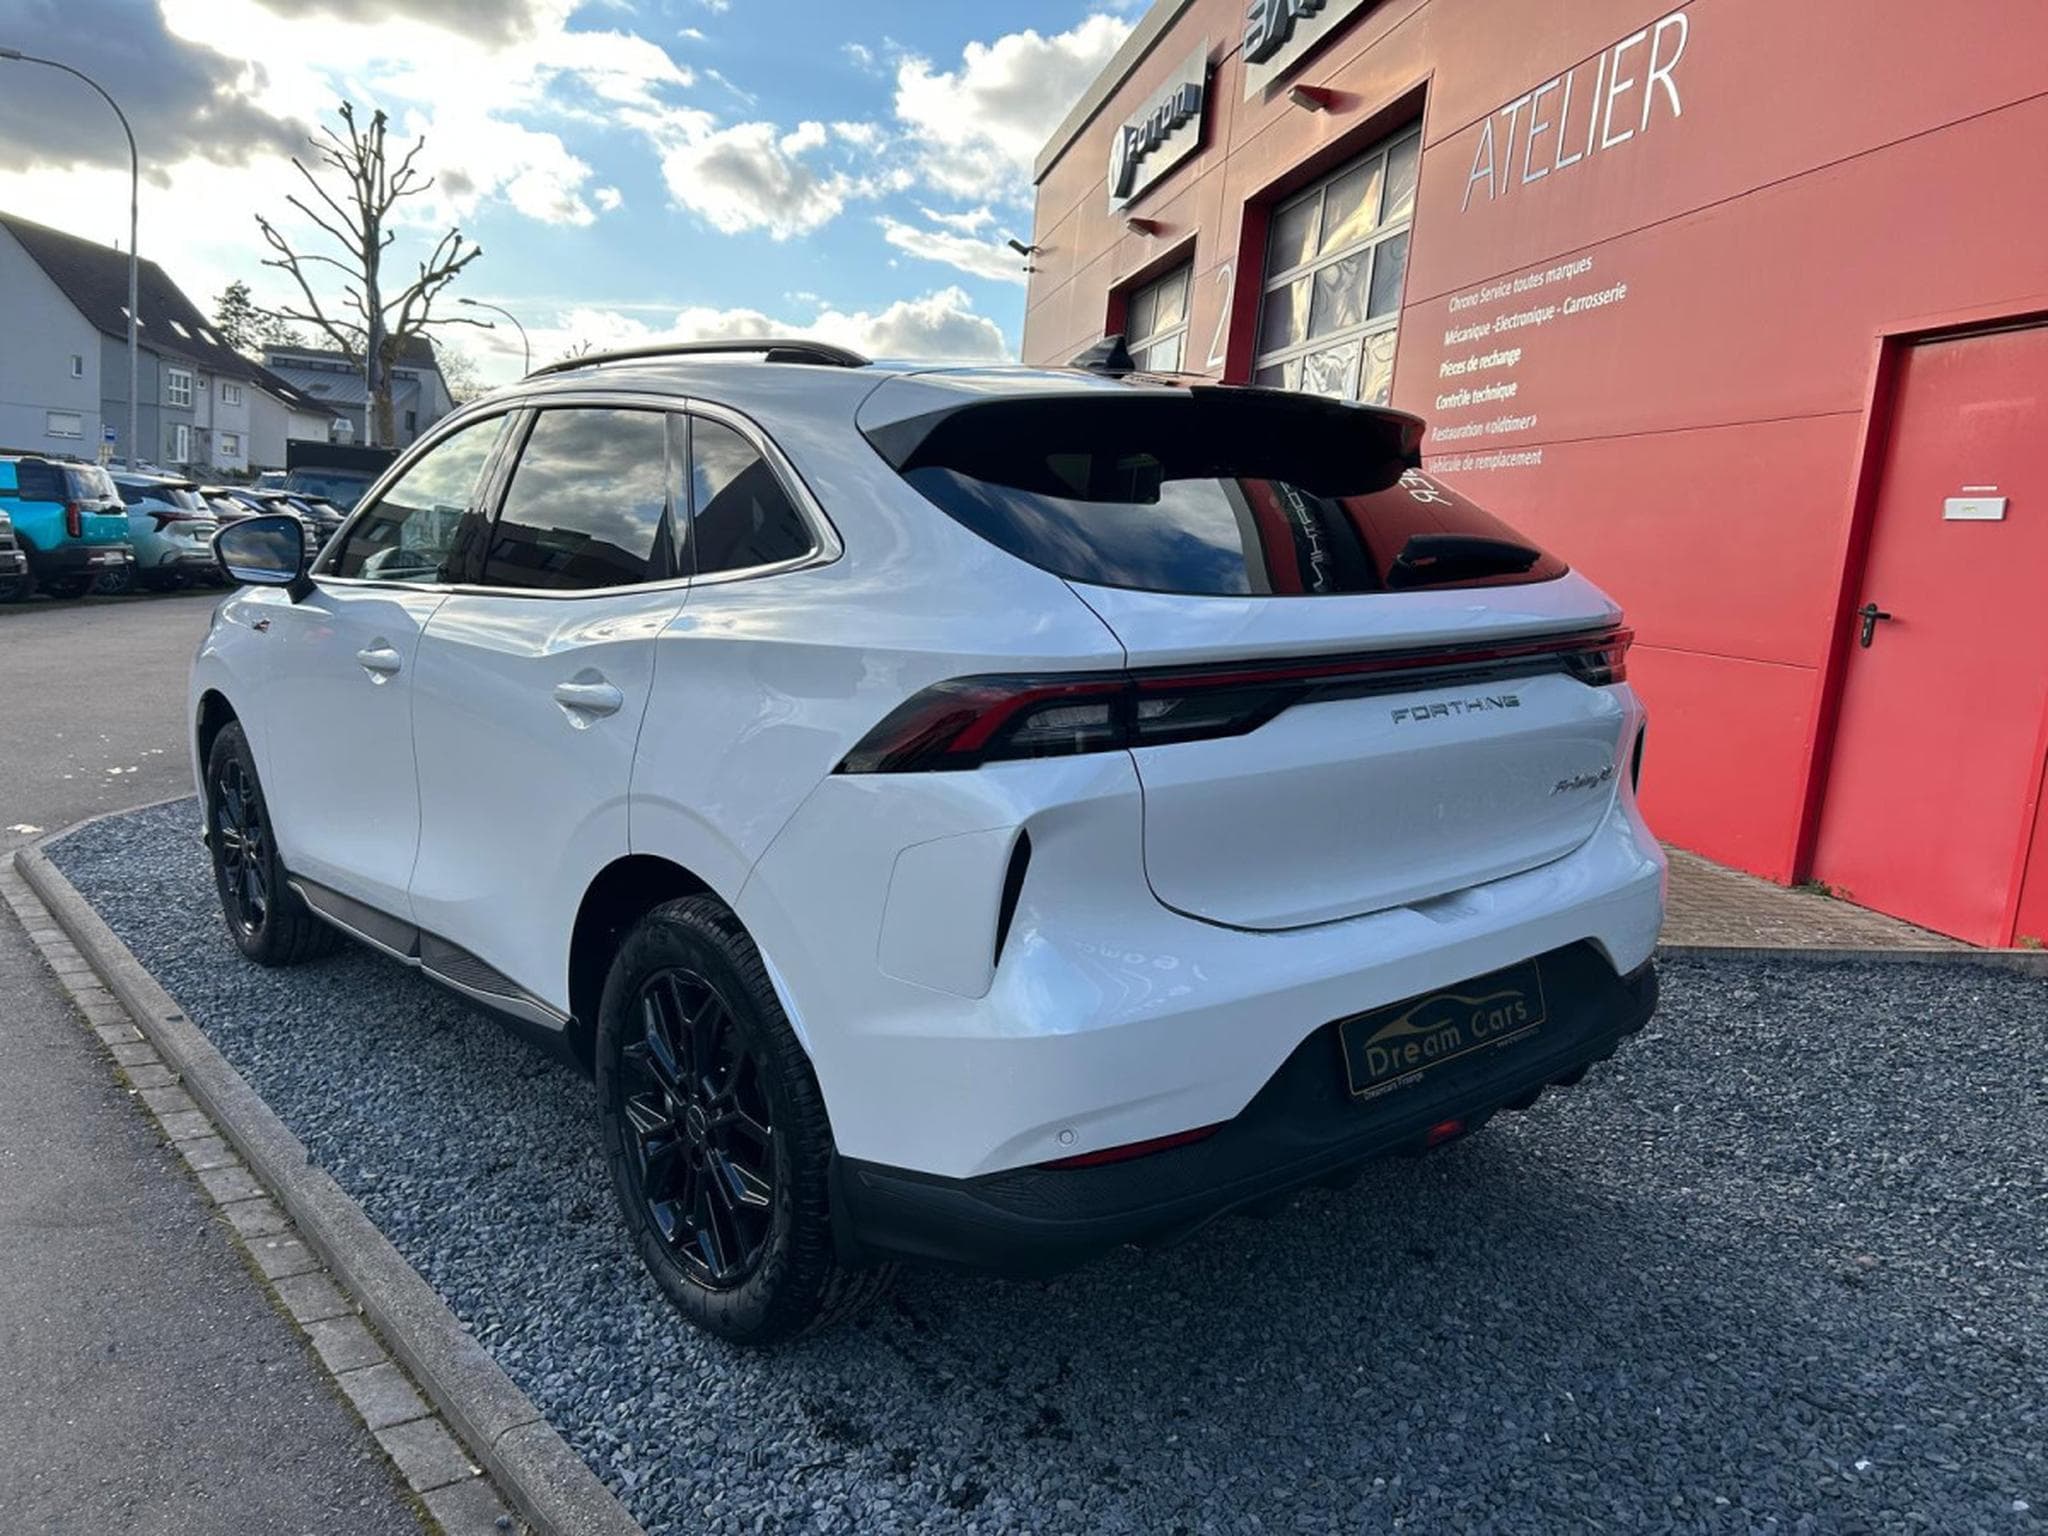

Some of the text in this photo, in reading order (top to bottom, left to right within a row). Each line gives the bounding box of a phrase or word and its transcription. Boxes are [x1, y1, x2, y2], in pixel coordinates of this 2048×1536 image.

[1461, 12, 1689, 213] ATELIER
[1449, 256, 1593, 312] Chrono Service toutes marques
[1206, 263, 1233, 368] 2
[1444, 322, 1491, 346] Mécanique
[1563, 281, 1628, 315] Carrosserie
[1440, 347, 1522, 378] Pièces de rechange
[1436, 381, 1518, 410] Contrôle technique
[1431, 420, 1484, 442] Restauration
[1462, 454, 1475, 471] de
[1475, 449, 1543, 472] remplacement
[1391, 694, 1521, 725] FORTHING
[1365, 1025, 1461, 1077] Dream
[1471, 999, 1527, 1038] Cars
